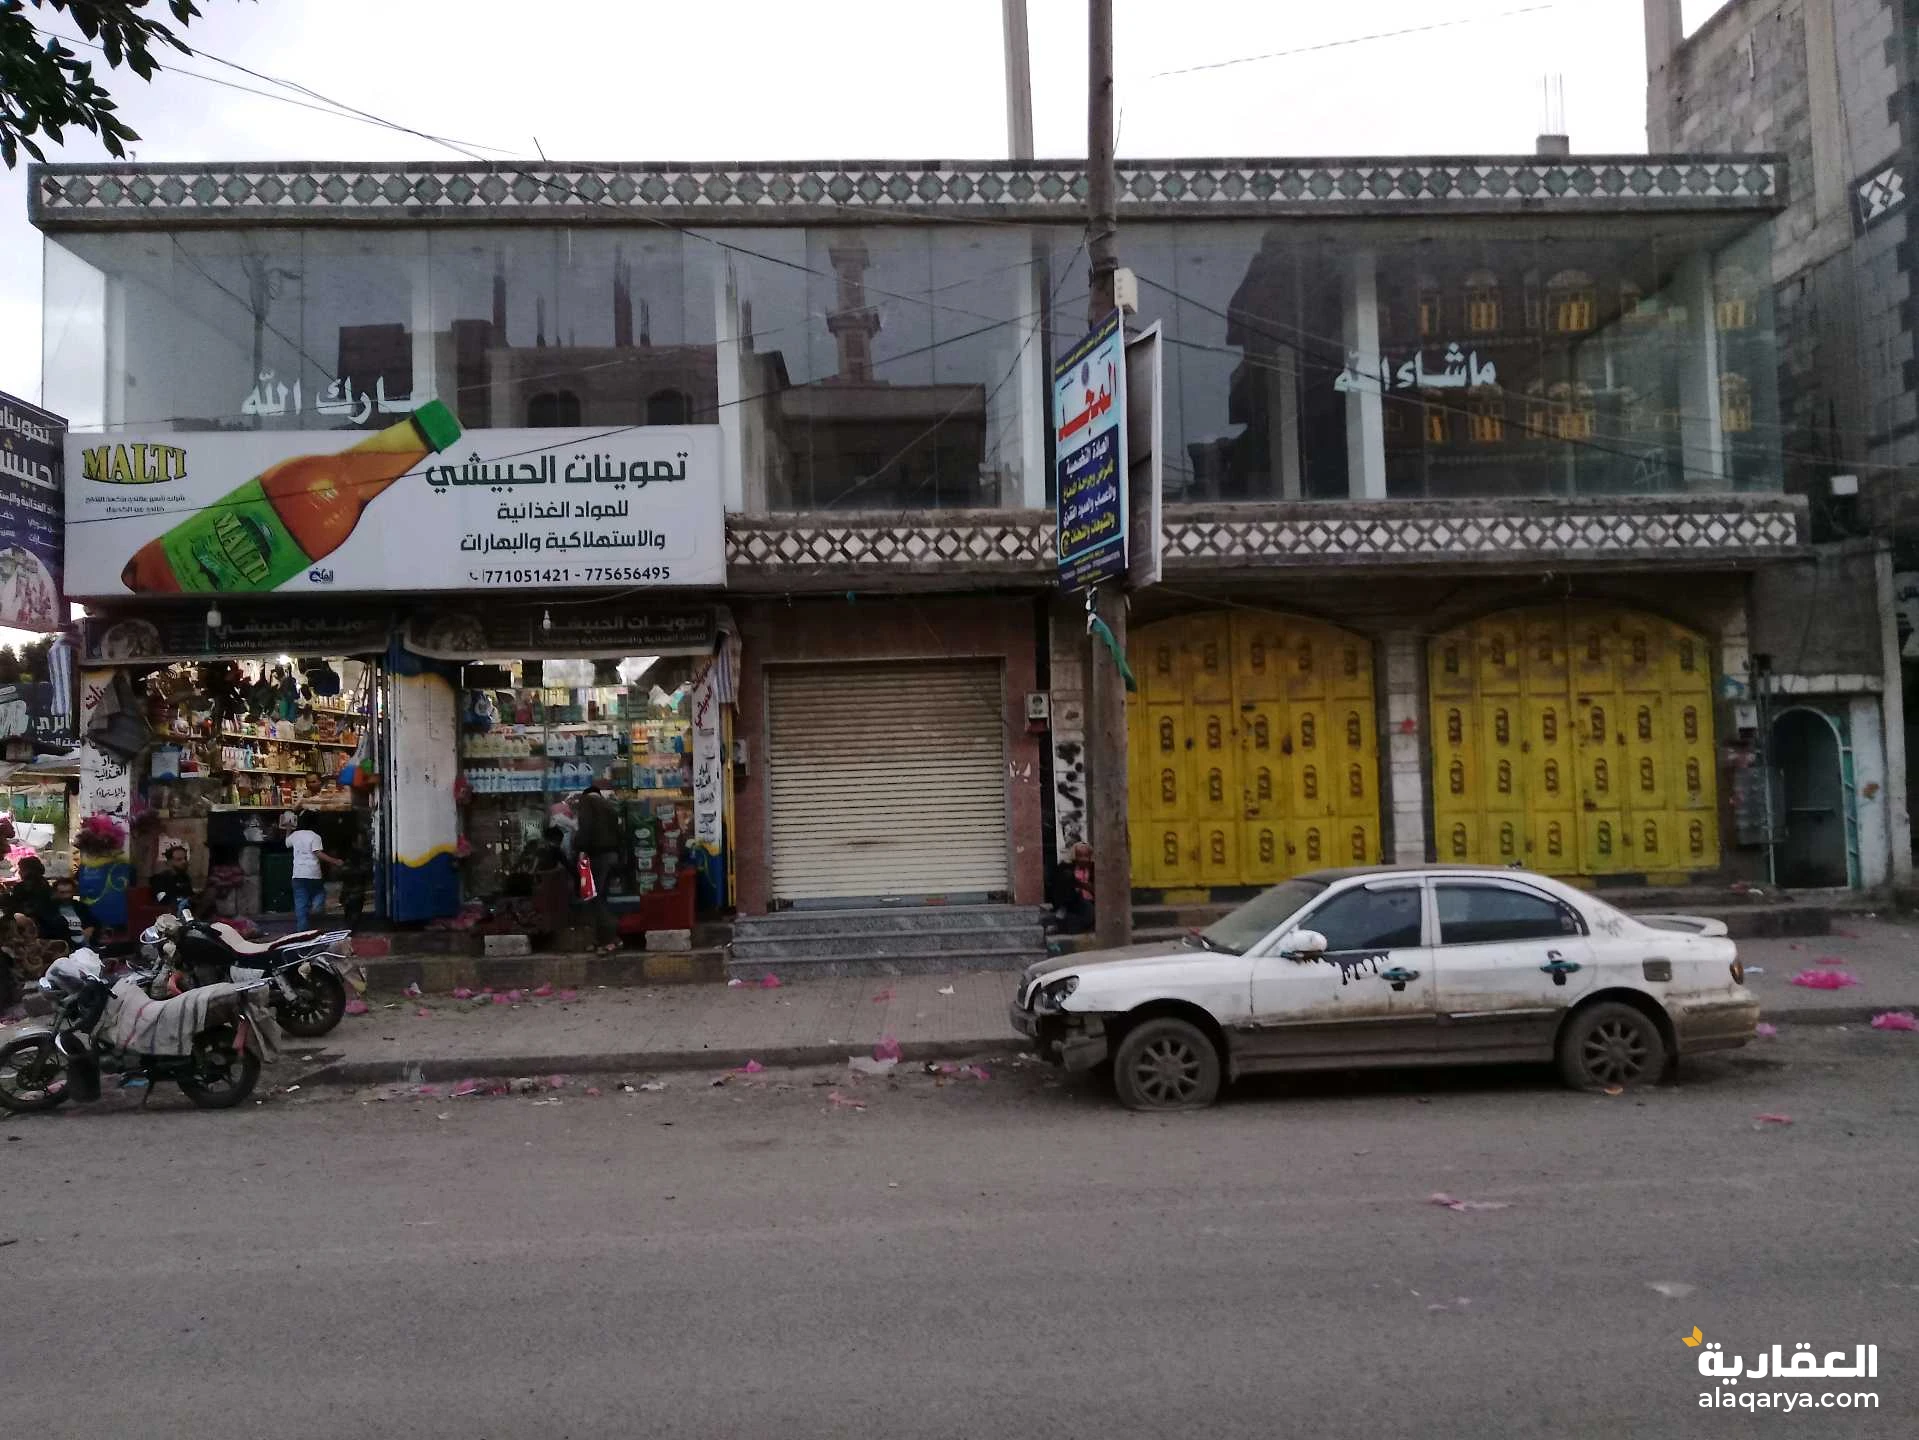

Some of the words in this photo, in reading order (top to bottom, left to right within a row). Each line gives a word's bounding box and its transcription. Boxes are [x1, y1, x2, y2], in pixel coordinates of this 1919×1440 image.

[241, 368, 302, 416] الله
[82, 443, 187, 484] MALTI
[425, 452, 556, 493] الحبيشي
[565, 451, 688, 489] تموينات
[575, 499, 629, 520] للمواد
[460, 532, 541, 555] والبهارات
[545, 530, 666, 553] والاستهلاكية
[484, 568, 570, 584] 771051421
[584, 566, 670, 582] 775656495
